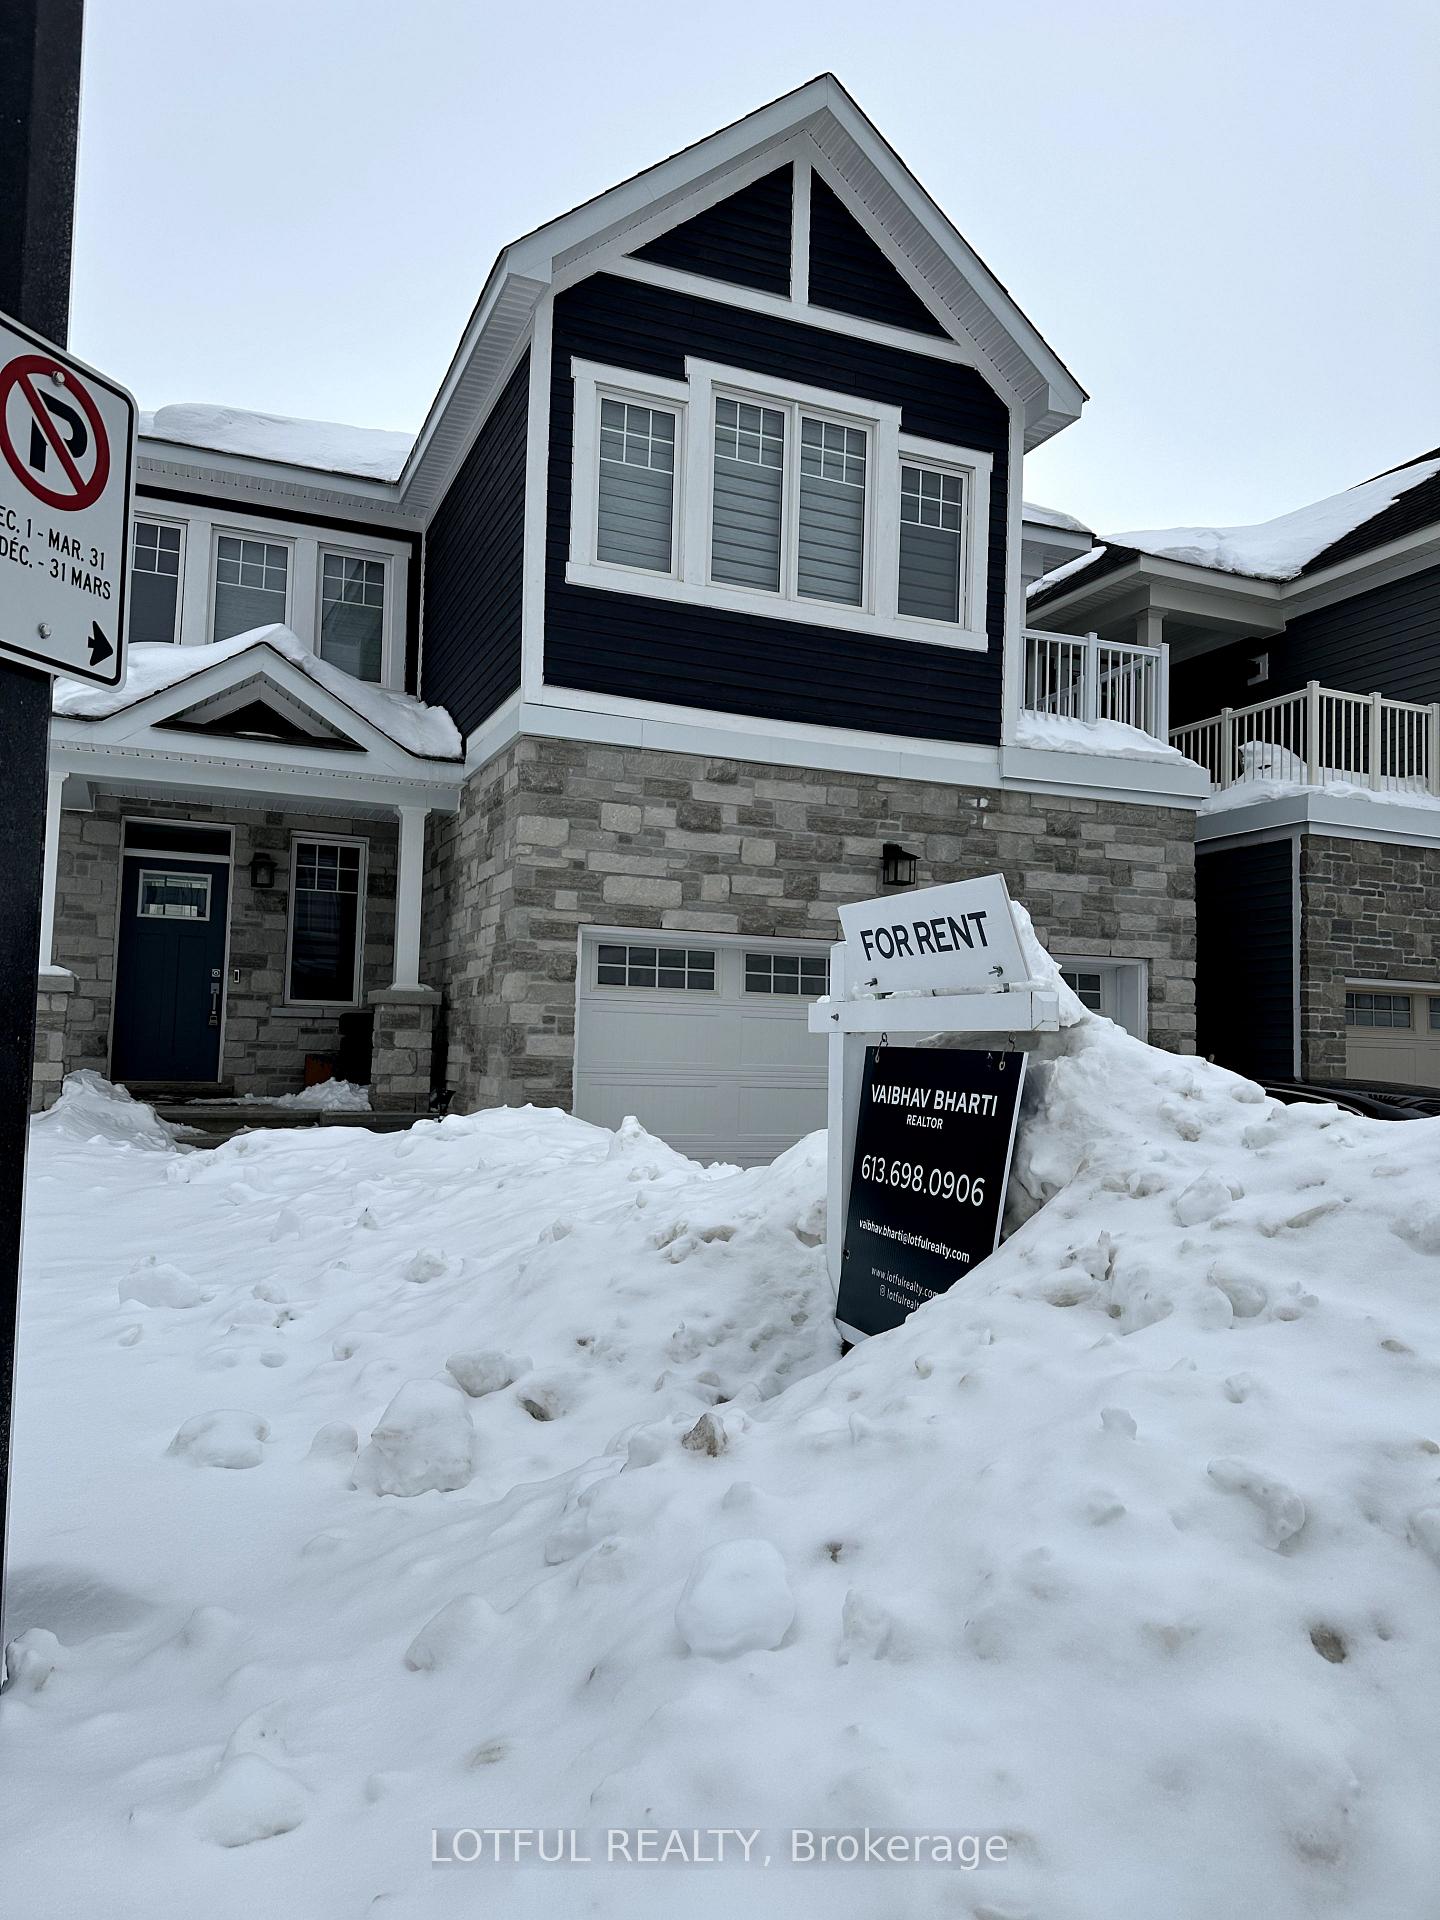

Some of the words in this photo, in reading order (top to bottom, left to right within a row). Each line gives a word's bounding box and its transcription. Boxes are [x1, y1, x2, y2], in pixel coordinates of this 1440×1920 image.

[29, 387, 88, 473] P
[0, 505, 20, 534] EC.
[27, 518, 32, 538] 1
[48, 528, 84, 562] MAR.
[89, 547, 105, 571] 31
[0, 535, 33, 569] DÉC.
[49, 558, 66, 582] 31
[71, 566, 111, 600] MARS
[860, 924, 915, 961] FOR
[912, 911, 988, 955] RENT
[871, 1083, 931, 1109] VAIBHAV
[933, 1089, 998, 1117] BHARTI
[906, 1114, 943, 1130] REALTOR
[861, 1154, 985, 1207] 613.698.0906
[859, 1219, 970, 1263] vaibhav.bharti@lotfulrealty.com
[886, 1288, 921, 1311] lotfulrealt
